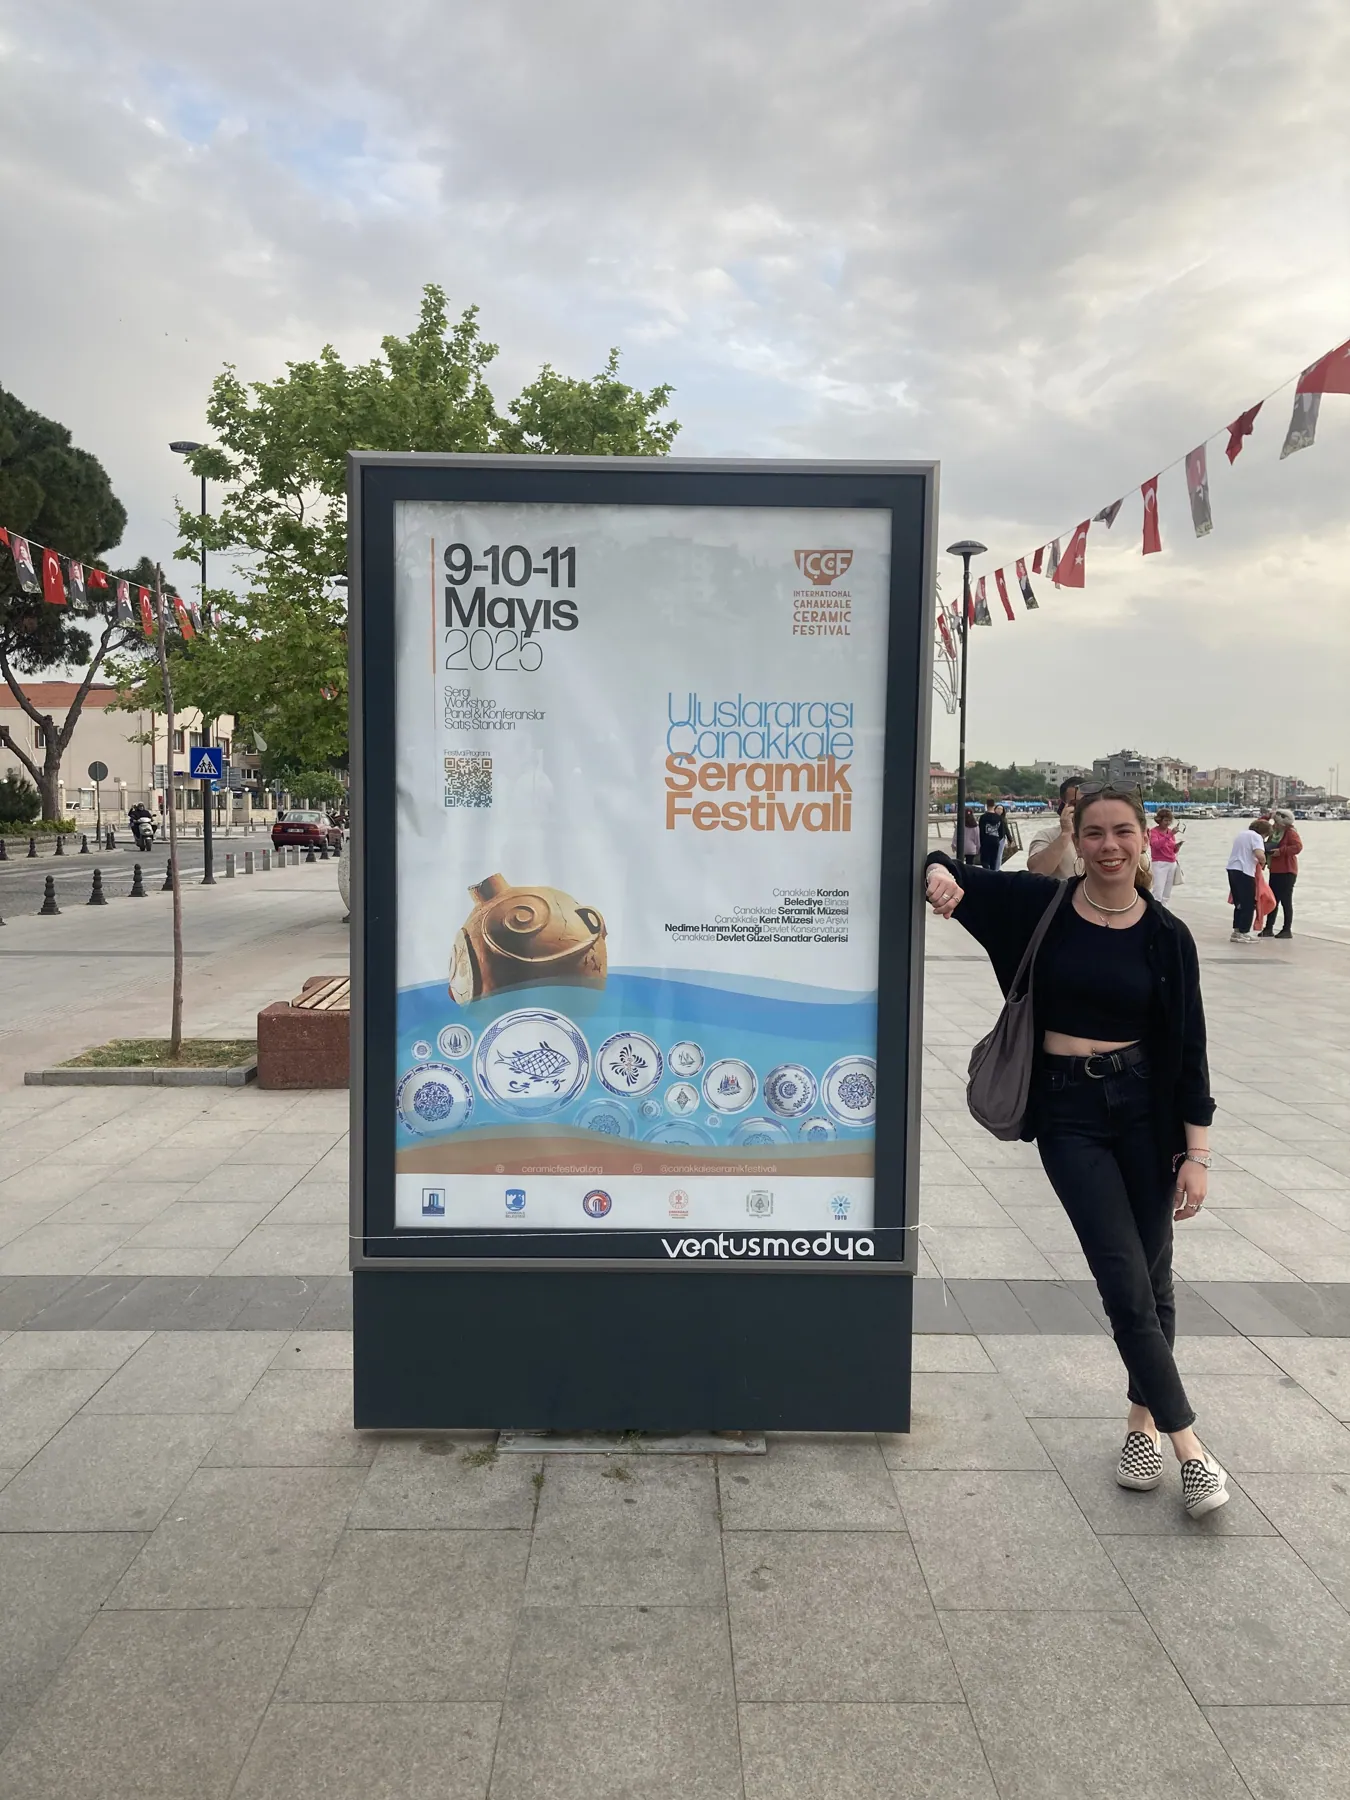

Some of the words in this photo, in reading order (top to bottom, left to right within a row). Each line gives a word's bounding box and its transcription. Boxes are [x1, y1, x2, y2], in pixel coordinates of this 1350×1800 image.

[444, 543, 576, 588] 9-10-11
[793, 600, 852, 610] ÇANAKKALE
[444, 587, 579, 638] Mayıs
[793, 611, 852, 622] CERAMIC
[792, 625, 850, 636] FESTIVAL
[445, 629, 544, 672] 2025
[444, 686, 471, 700] Sergi
[444, 697, 496, 710] Workshop
[668, 692, 854, 728] Uluslararası
[444, 707, 472, 718] Panel
[474, 707, 482, 718] &
[483, 708, 546, 720] Konferanslar
[444, 718, 472, 731] Satış
[472, 719, 516, 730] Standları
[666, 721, 854, 766] Çanakkale
[664, 752, 852, 792] Seramik
[666, 791, 852, 832] Festivali
[772, 888, 816, 898] Çanakkale
[817, 888, 849, 897] Kordon
[784, 898, 823, 908] Belediye
[734, 906, 776, 916] Çanakkale
[778, 906, 816, 915] Seramik
[817, 907, 849, 915] Müzesi
[715, 915, 758, 924] Çanakkale
[760, 916, 780, 924] Kent
[782, 916, 813, 924] Müzesi
[826, 916, 848, 925] Arşivi
[665, 924, 700, 932] Nedime
[701, 924, 730, 932] Hanım
[732, 924, 762, 936] Konağı
[763, 925, 790, 933] Devlet
[672, 933, 715, 942] Çanakkale
[716, 933, 745, 942] Devlet
[746, 932, 772, 942] Güzel
[773, 934, 812, 942] Sanatlar
[814, 934, 848, 942] Galerisi
[522, 1164, 603, 1174] ceramicfestival.org
[661, 1232, 875, 1260] ventusmedya
